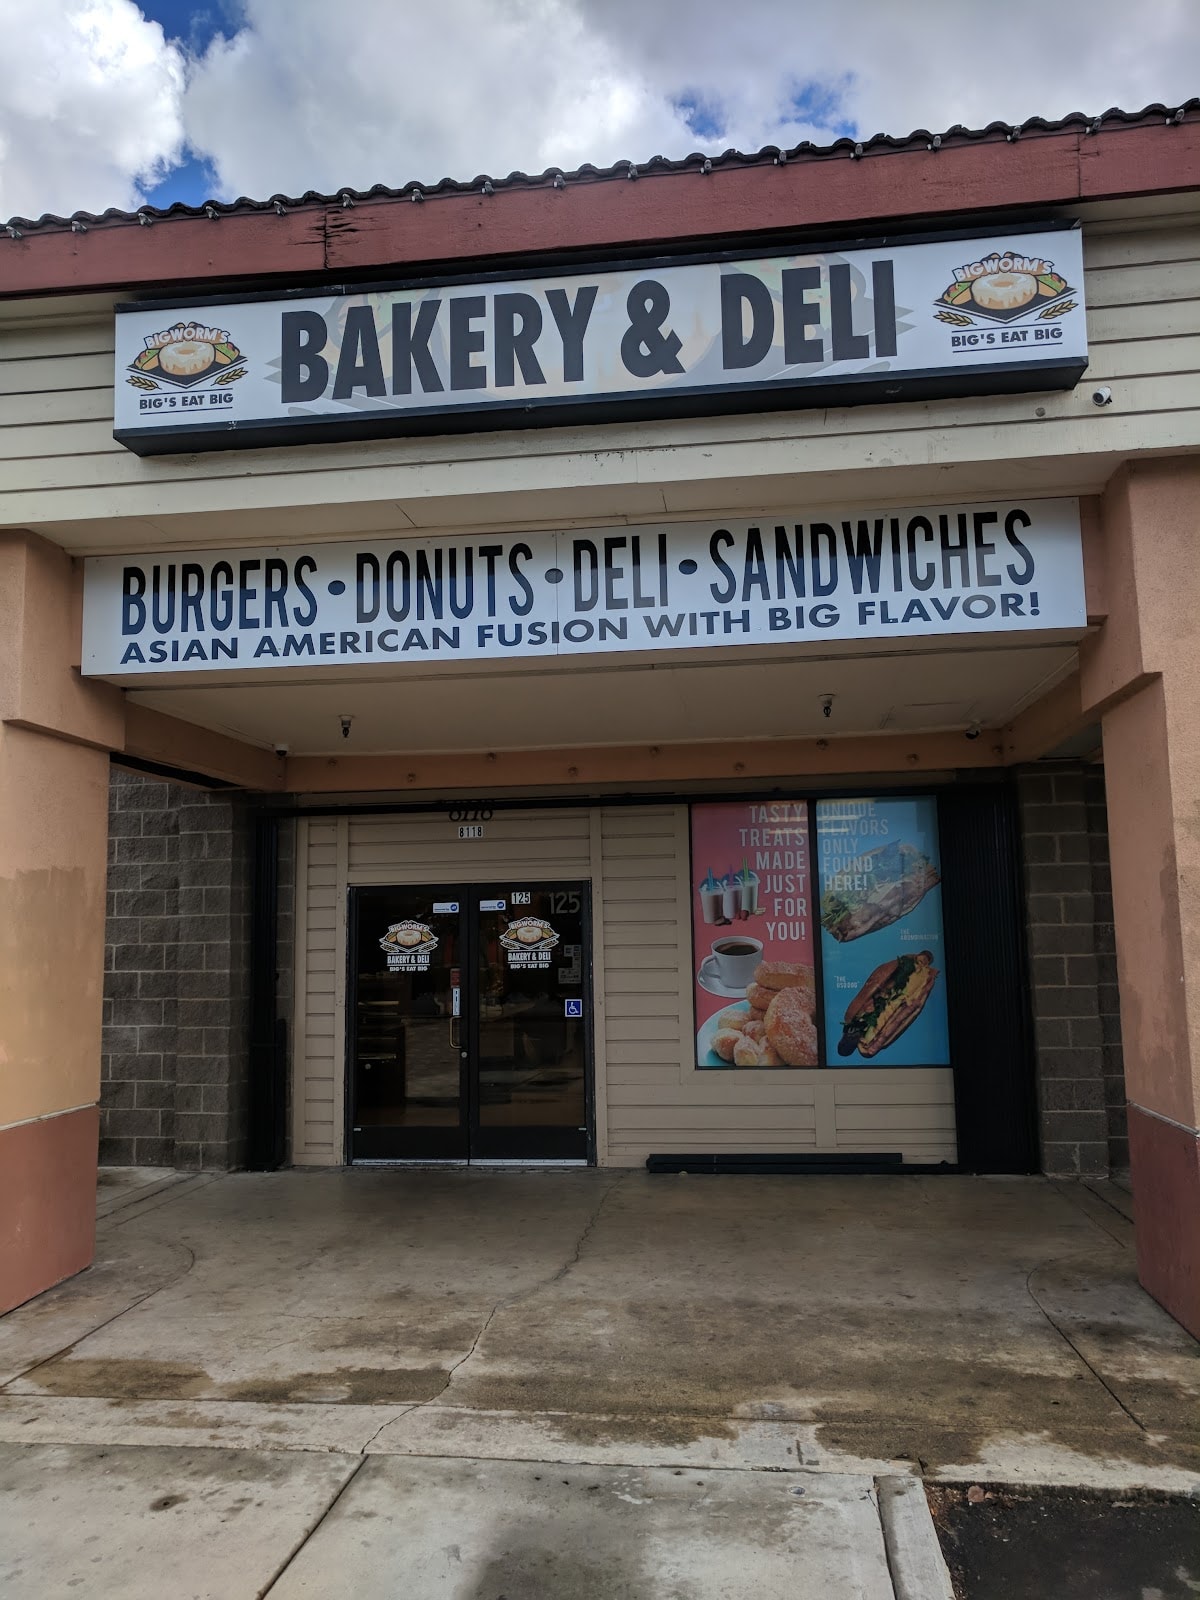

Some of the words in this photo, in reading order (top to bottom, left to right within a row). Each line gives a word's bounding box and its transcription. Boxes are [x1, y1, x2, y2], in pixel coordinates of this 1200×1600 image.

[953, 255, 1054, 282] BIGWORM'S
[144, 322, 231, 347] BIGWORM'S
[281, 285, 599, 404] BAKERY
[620, 279, 686, 378] &
[720, 259, 898, 370] DELI
[951, 330, 996, 348] BIG'S
[1000, 329, 1029, 344] EAT
[1034, 326, 1063, 342] BIG
[139, 395, 176, 410] BIG'S
[181, 394, 205, 408] EAT
[209, 391, 234, 406] BIG
[121, 554, 318, 636] BURGERS
[356, 542, 534, 624] DONUTS
[572, 532, 668, 612] DELI
[708, 507, 1036, 604] SANDWICHES
[119, 636, 239, 665] ASIAN
[253, 625, 460, 659] AMERICAN
[477, 615, 628, 649] FUSION
[643, 608, 750, 639] WITH
[768, 602, 840, 632] BIG
[857, 591, 1040, 626] FLAVOR!
[749, 804, 804, 824] TASTY
[459, 826, 482, 838] 8118
[739, 827, 805, 847] TREATS
[822, 818, 889, 836] FLAVORS
[822, 838, 858, 854] ONLY
[755, 850, 806, 870] MADE
[823, 856, 873, 873] FOUND
[764, 874, 806, 894] JUST
[824, 874, 868, 891] HERE!
[513, 892, 530, 904] 125
[549, 891, 581, 915] 125
[773, 897, 807, 917] FOR
[766, 921, 806, 941] YOU!
[387, 955, 410, 964] BAKERY
[411, 955, 416, 963] &
[417, 954, 429, 964] DELI
[507, 952, 530, 961] BAKERY
[532, 952, 537, 960] &
[538, 951, 551, 960] DELI
